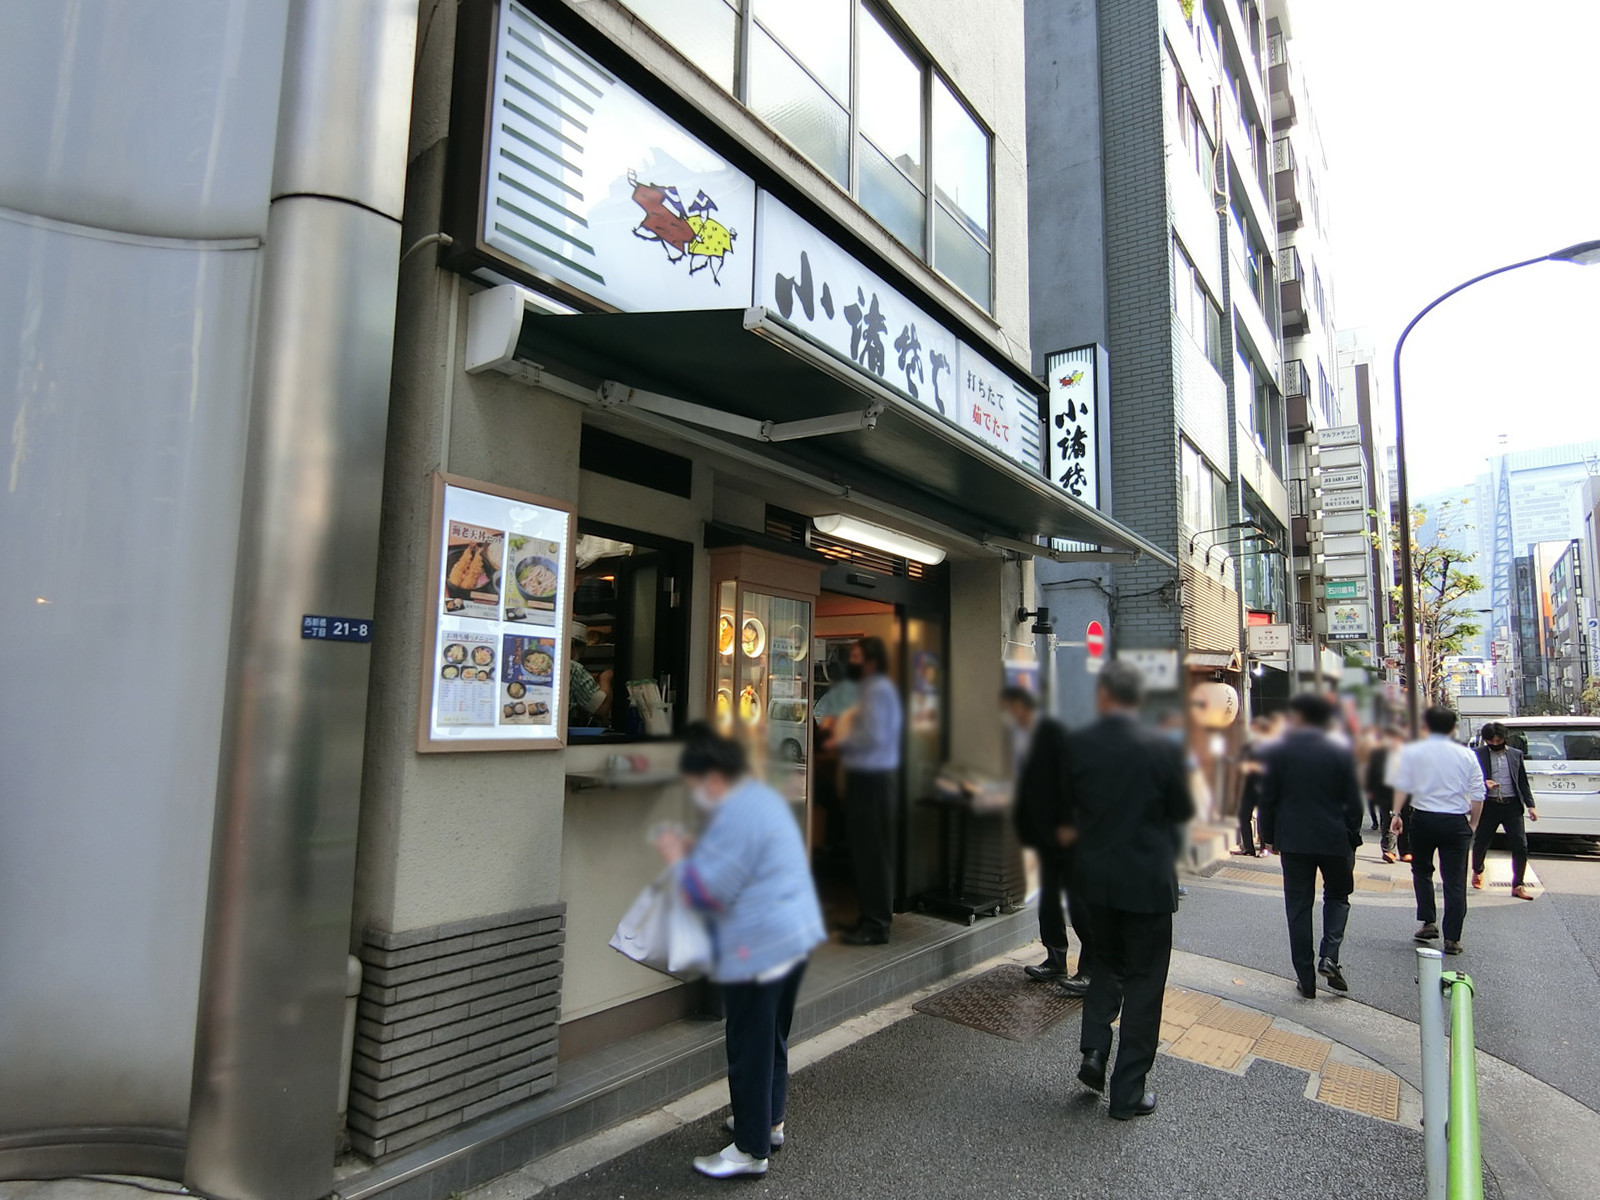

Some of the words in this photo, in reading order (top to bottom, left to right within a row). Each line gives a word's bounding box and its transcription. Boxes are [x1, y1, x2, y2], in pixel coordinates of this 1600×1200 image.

[967, 370, 1004, 411] 打ちたて
[972, 404, 1009, 442] 茹でたて
[451, 524, 503, 544] 海老天丼セット
[303, 627, 327, 637] 一丁目
[333, 621, 368, 637] 21-8
